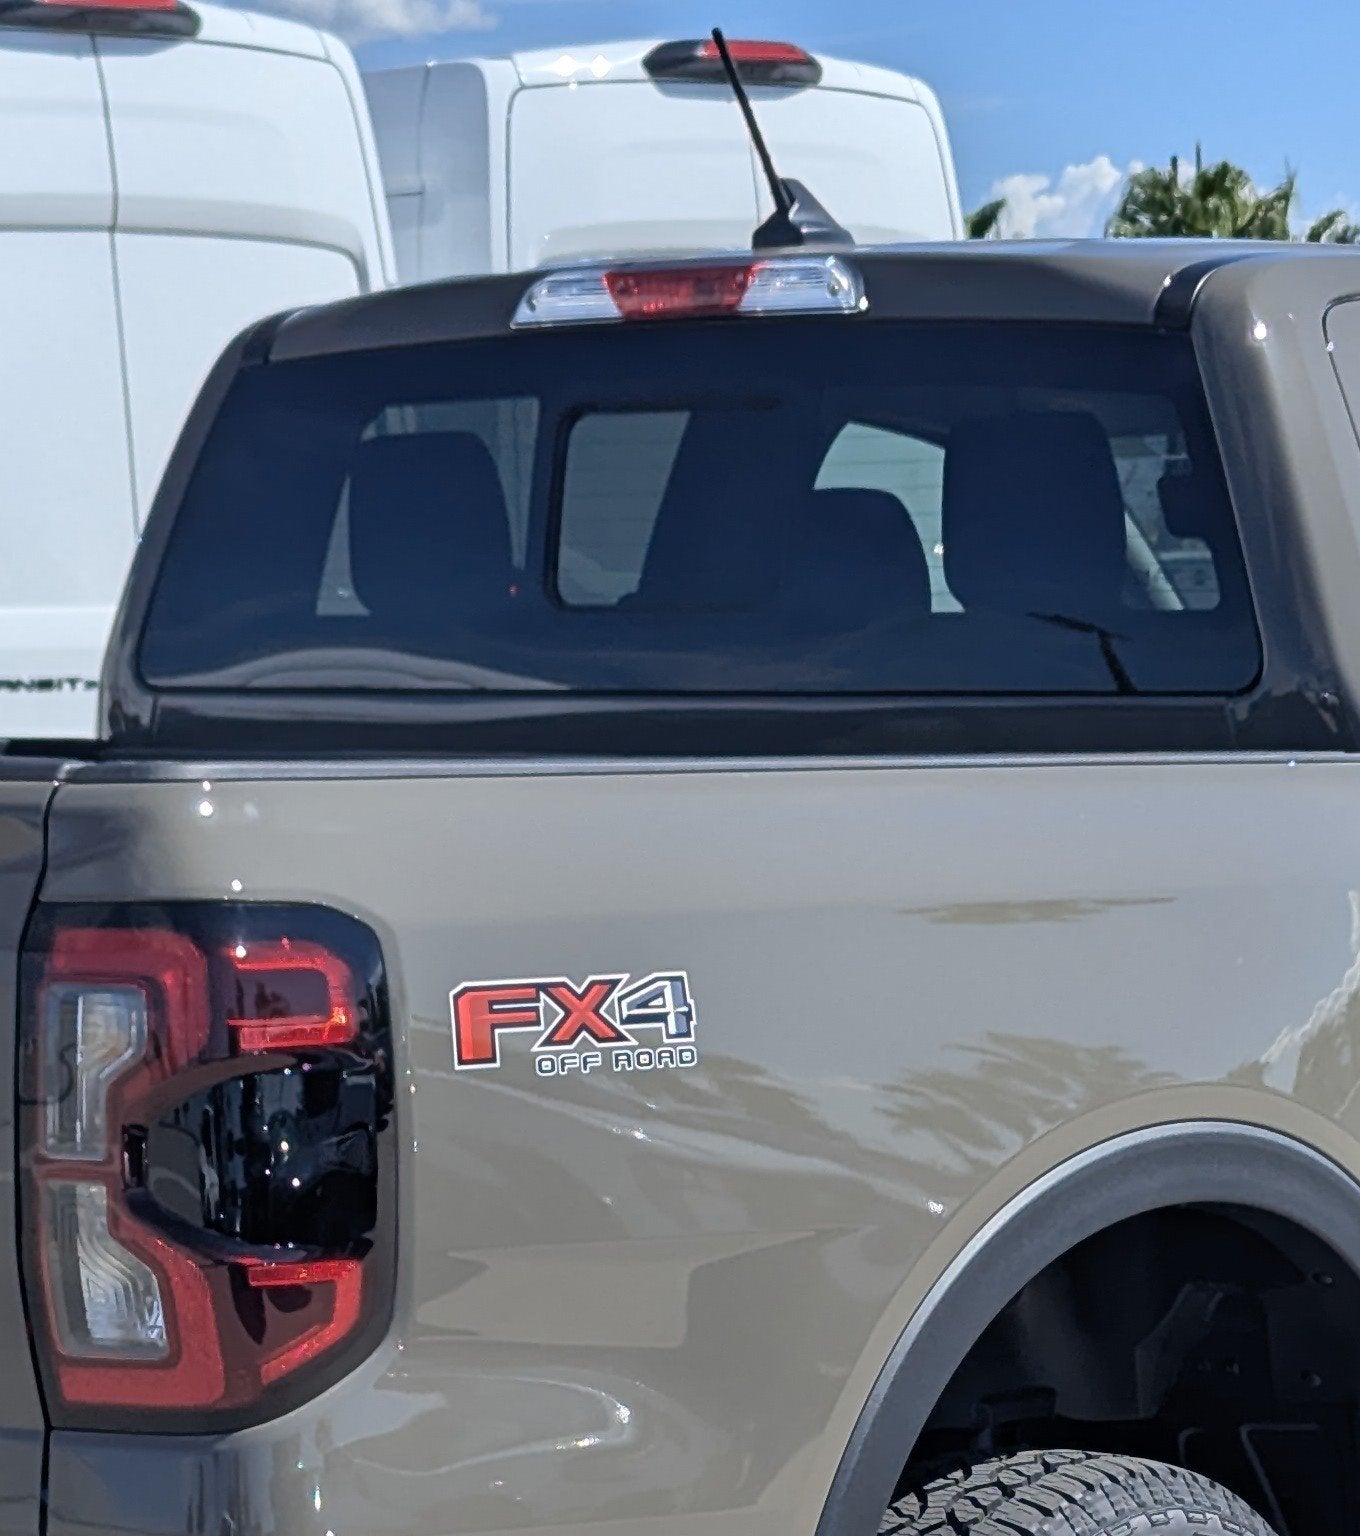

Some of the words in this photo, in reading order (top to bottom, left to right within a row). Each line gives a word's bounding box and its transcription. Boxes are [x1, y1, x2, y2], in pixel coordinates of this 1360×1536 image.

[449, 971, 697, 1070] FX4
[536, 1051, 601, 1077] OFF
[613, 1045, 697, 1072] ROAD
